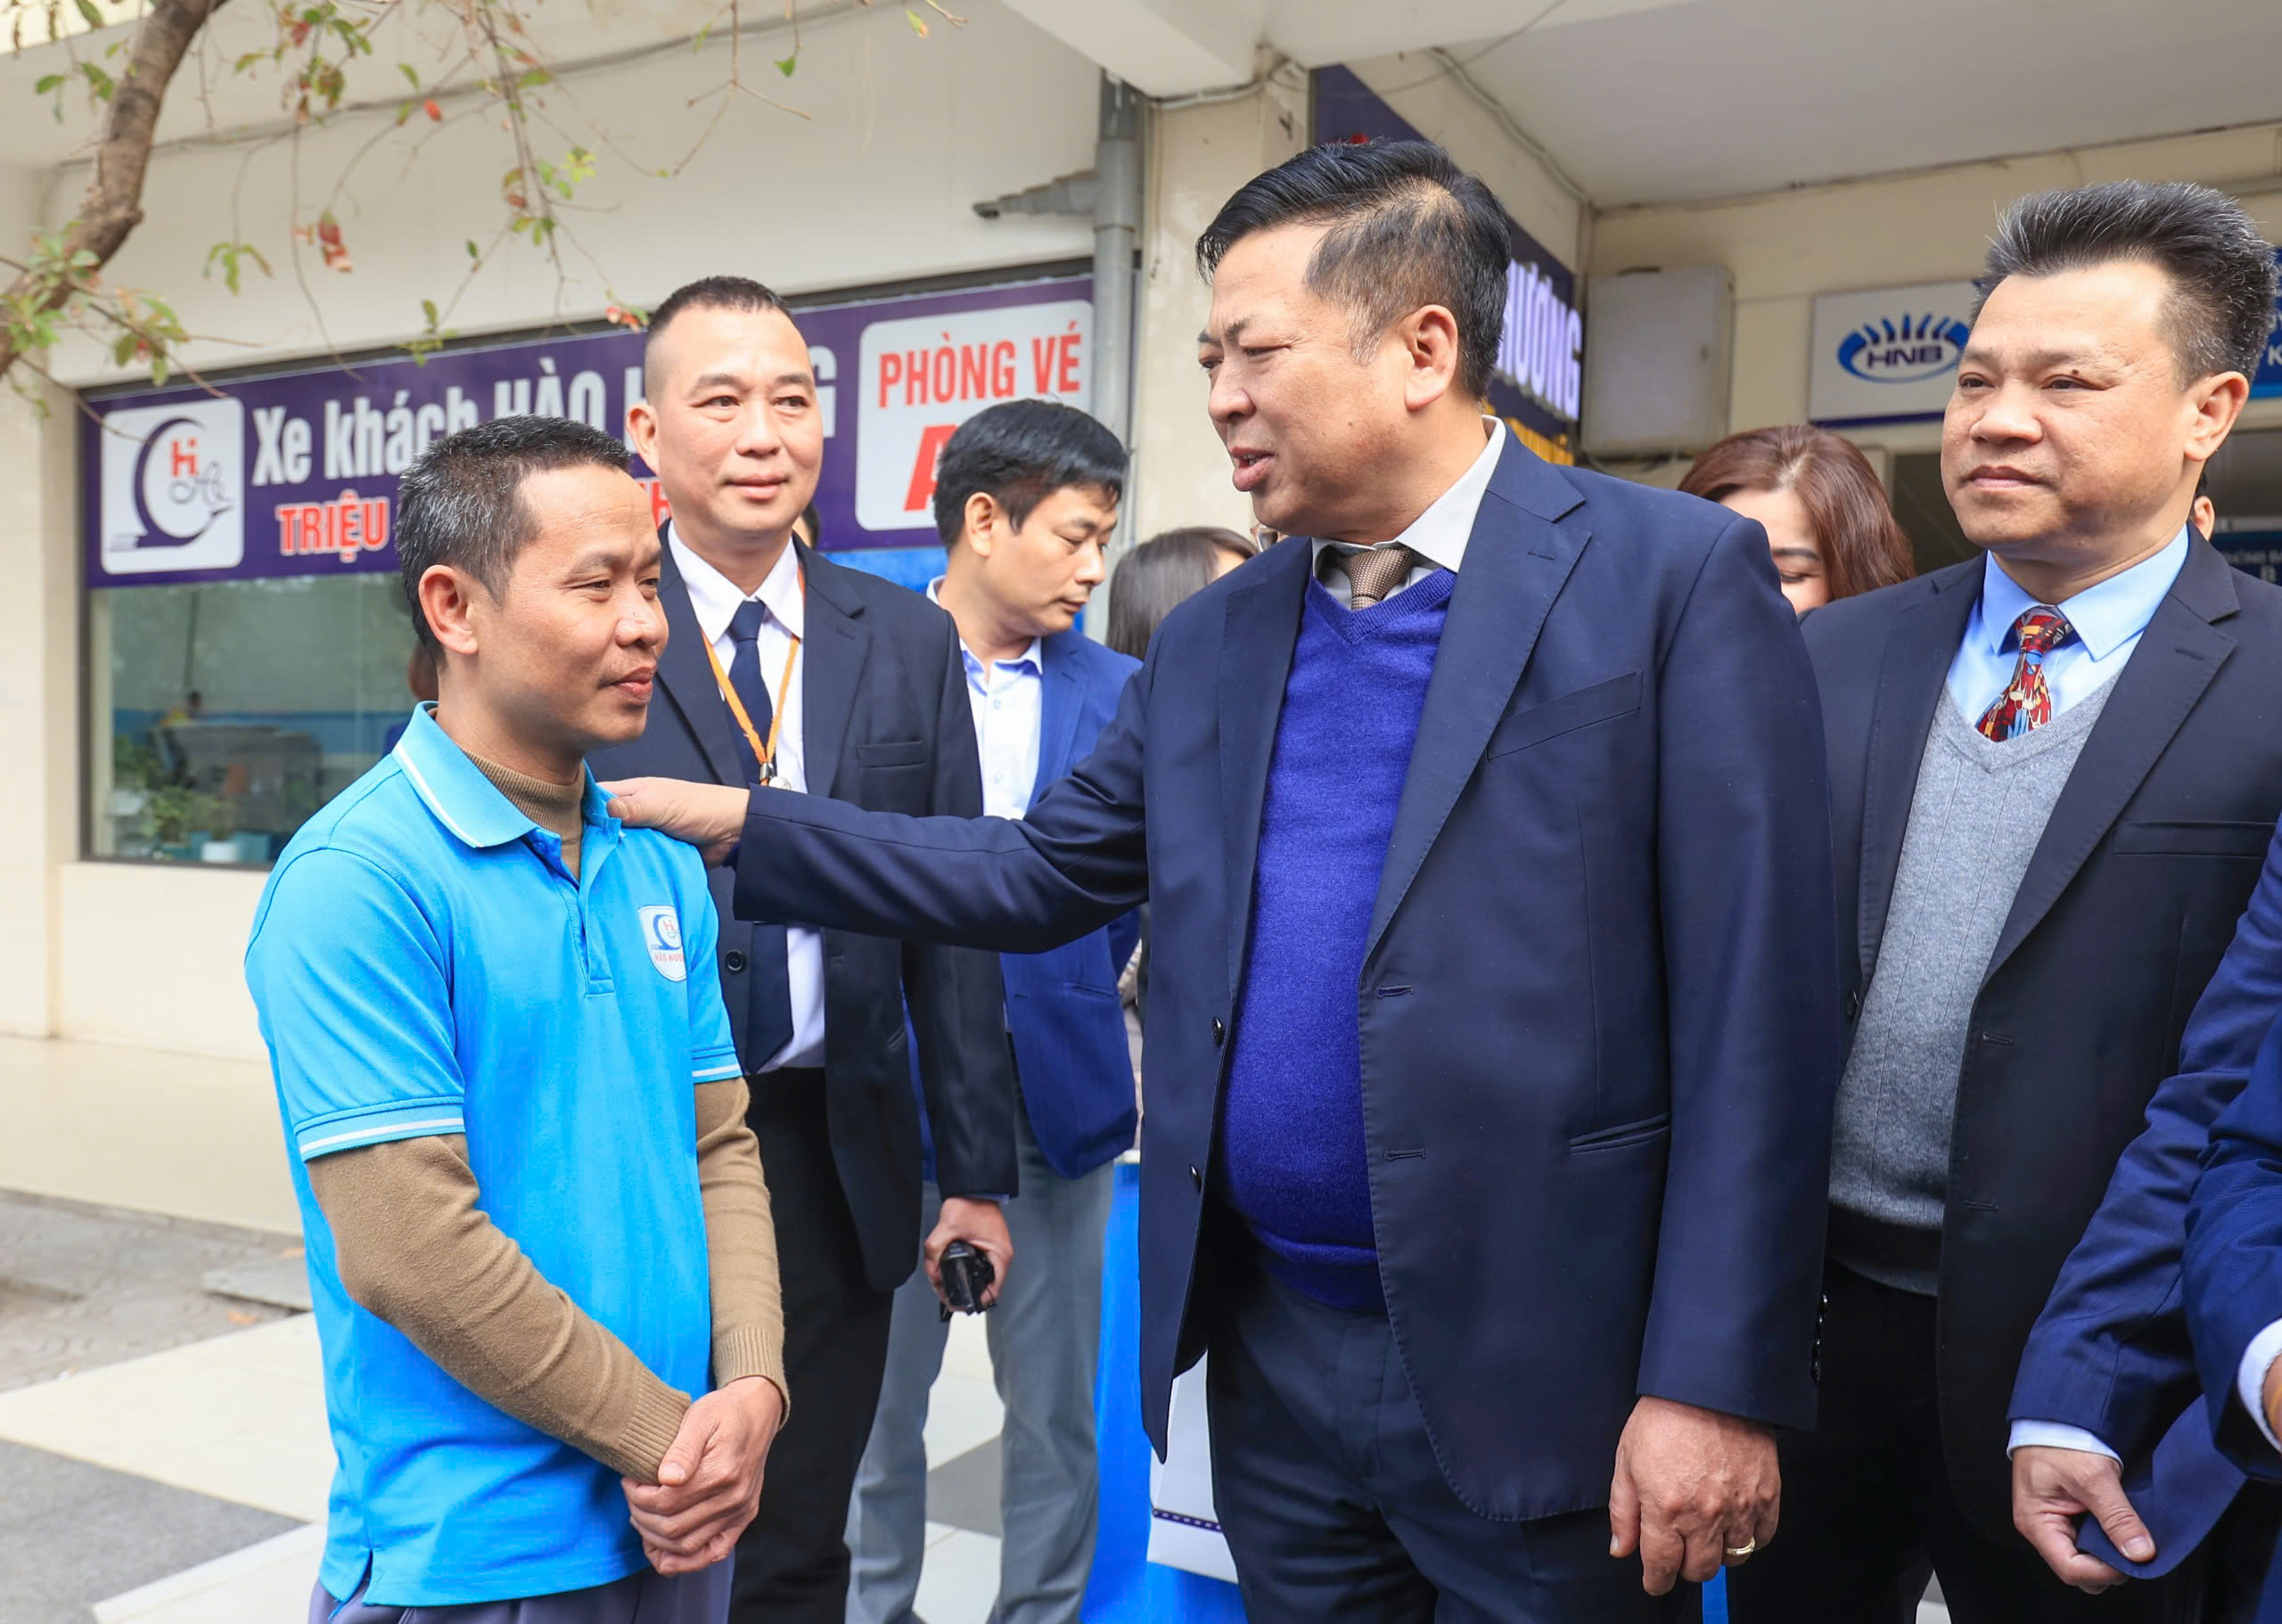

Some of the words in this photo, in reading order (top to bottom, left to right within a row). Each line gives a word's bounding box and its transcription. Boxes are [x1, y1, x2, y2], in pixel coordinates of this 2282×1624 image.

[878, 332, 1016, 408] PHÒNG
[1031, 320, 1081, 395] VÉ
[1867, 346, 1942, 368] HNB
[252, 406, 312, 486] Xe
[276, 489, 390, 562] TRIỆU
